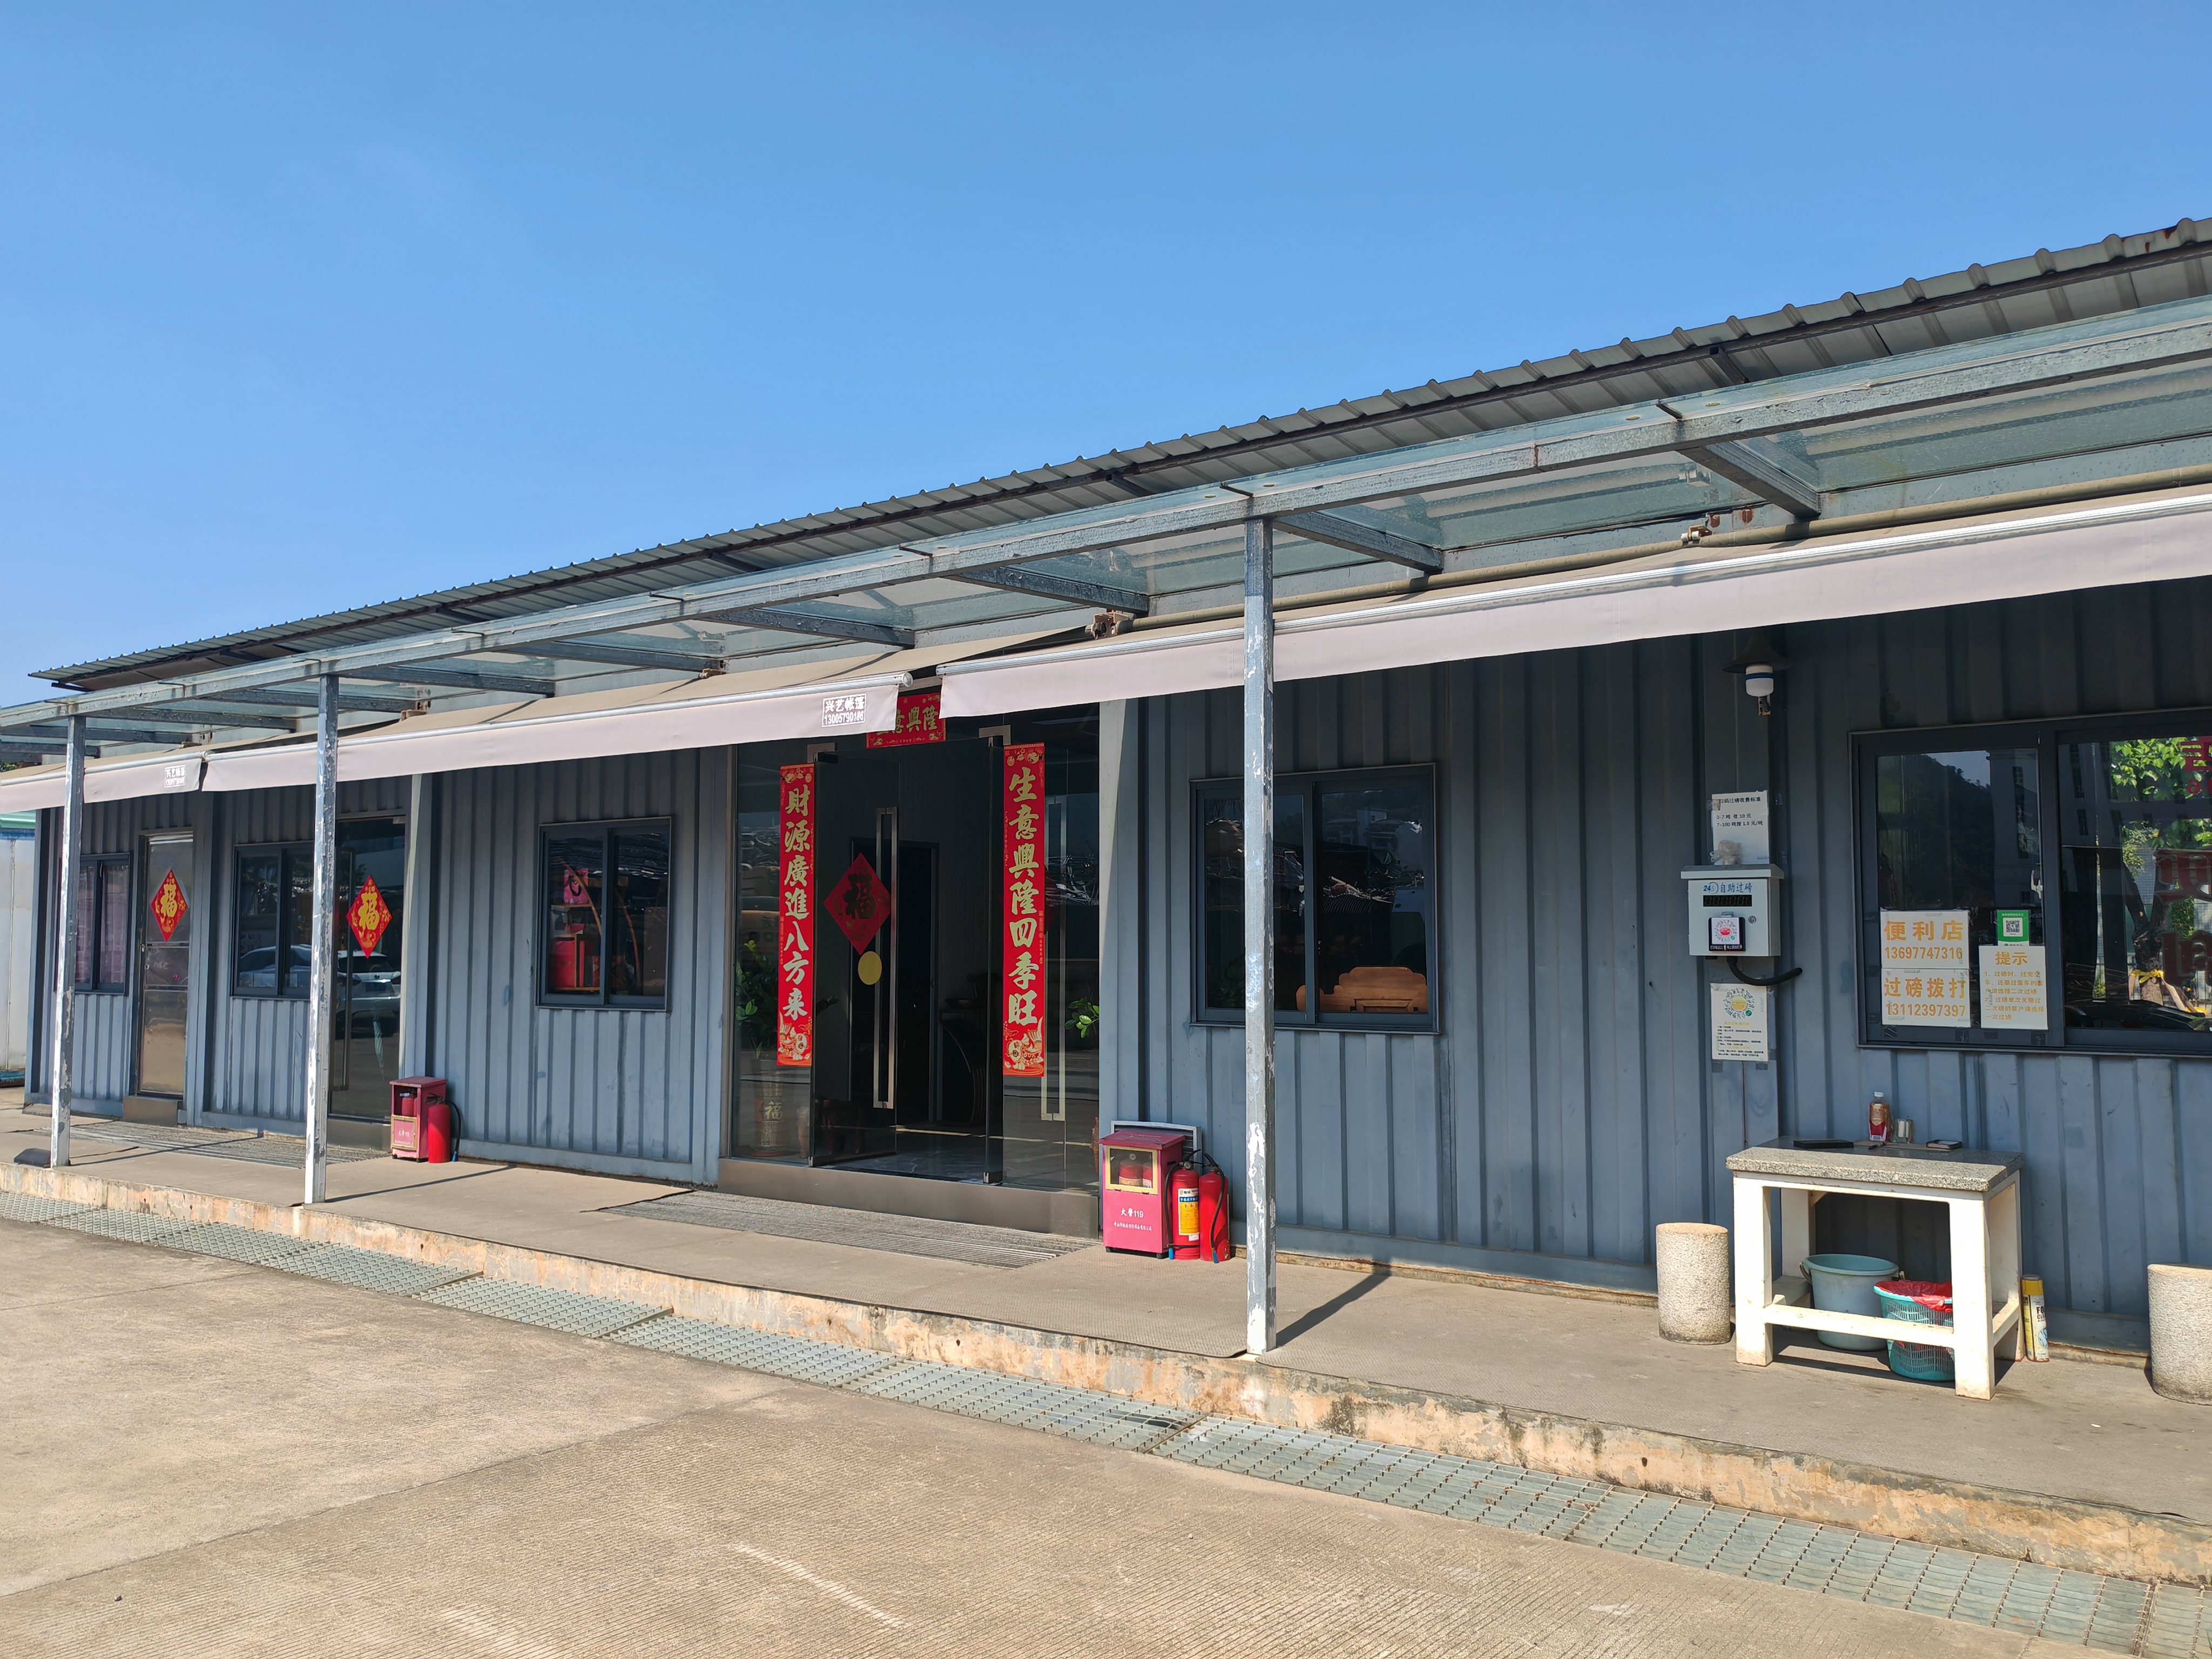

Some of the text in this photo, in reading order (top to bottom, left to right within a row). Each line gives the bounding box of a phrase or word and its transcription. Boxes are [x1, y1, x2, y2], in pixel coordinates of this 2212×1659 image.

[824, 711, 864, 725] 13005790186
[160, 884, 177, 918] 福
[843, 873, 878, 920] 福
[358, 892, 380, 930] 福
[1884, 920, 1964, 941] 便利店
[1885, 947, 1963, 959] 13697747316
[1995, 952, 2027, 965] 提示
[1884, 977, 1966, 999] 过磅拨打
[1886, 1003, 1966, 1017] 13112397397
[764, 1100, 783, 1120] 福
